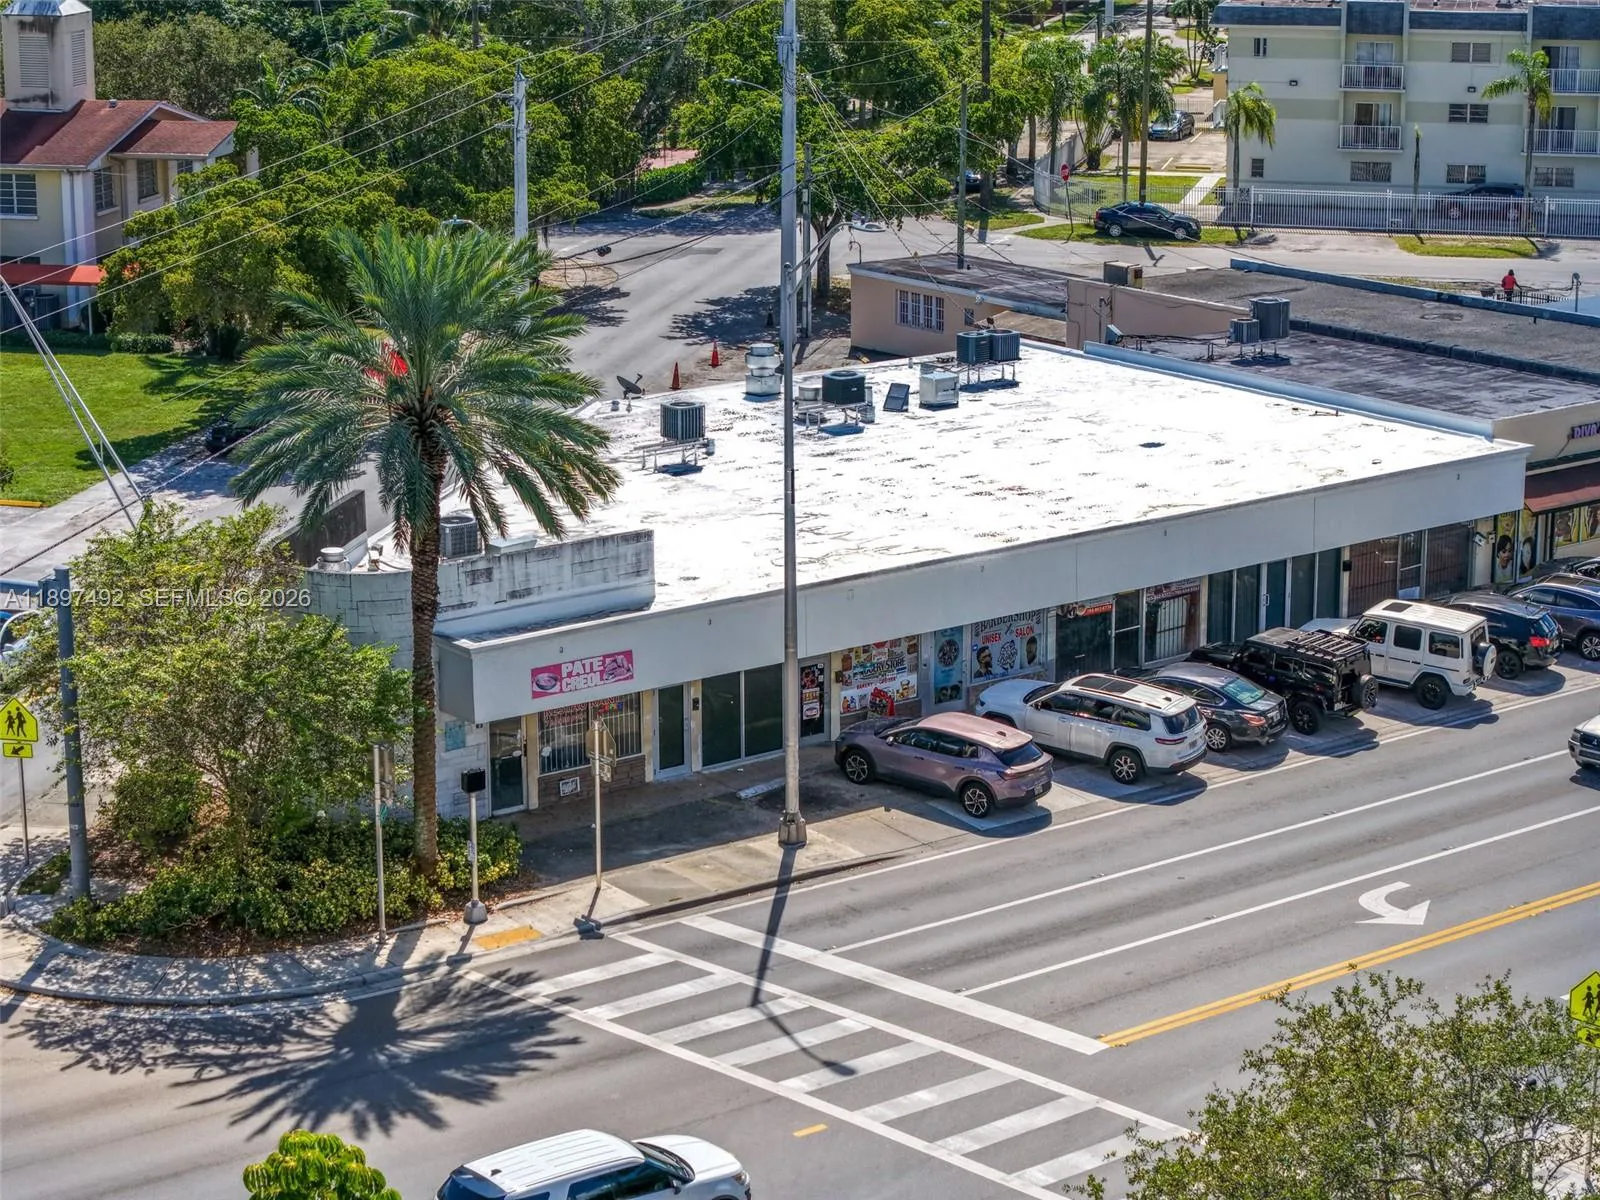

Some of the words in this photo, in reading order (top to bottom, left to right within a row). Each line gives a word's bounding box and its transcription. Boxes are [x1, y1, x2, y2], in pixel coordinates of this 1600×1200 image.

[981, 632, 1002, 644] UNISEX
[1015, 625, 1034, 638] SALON
[561, 656, 604, 678] PATE
[885, 657, 906, 669] STORE
